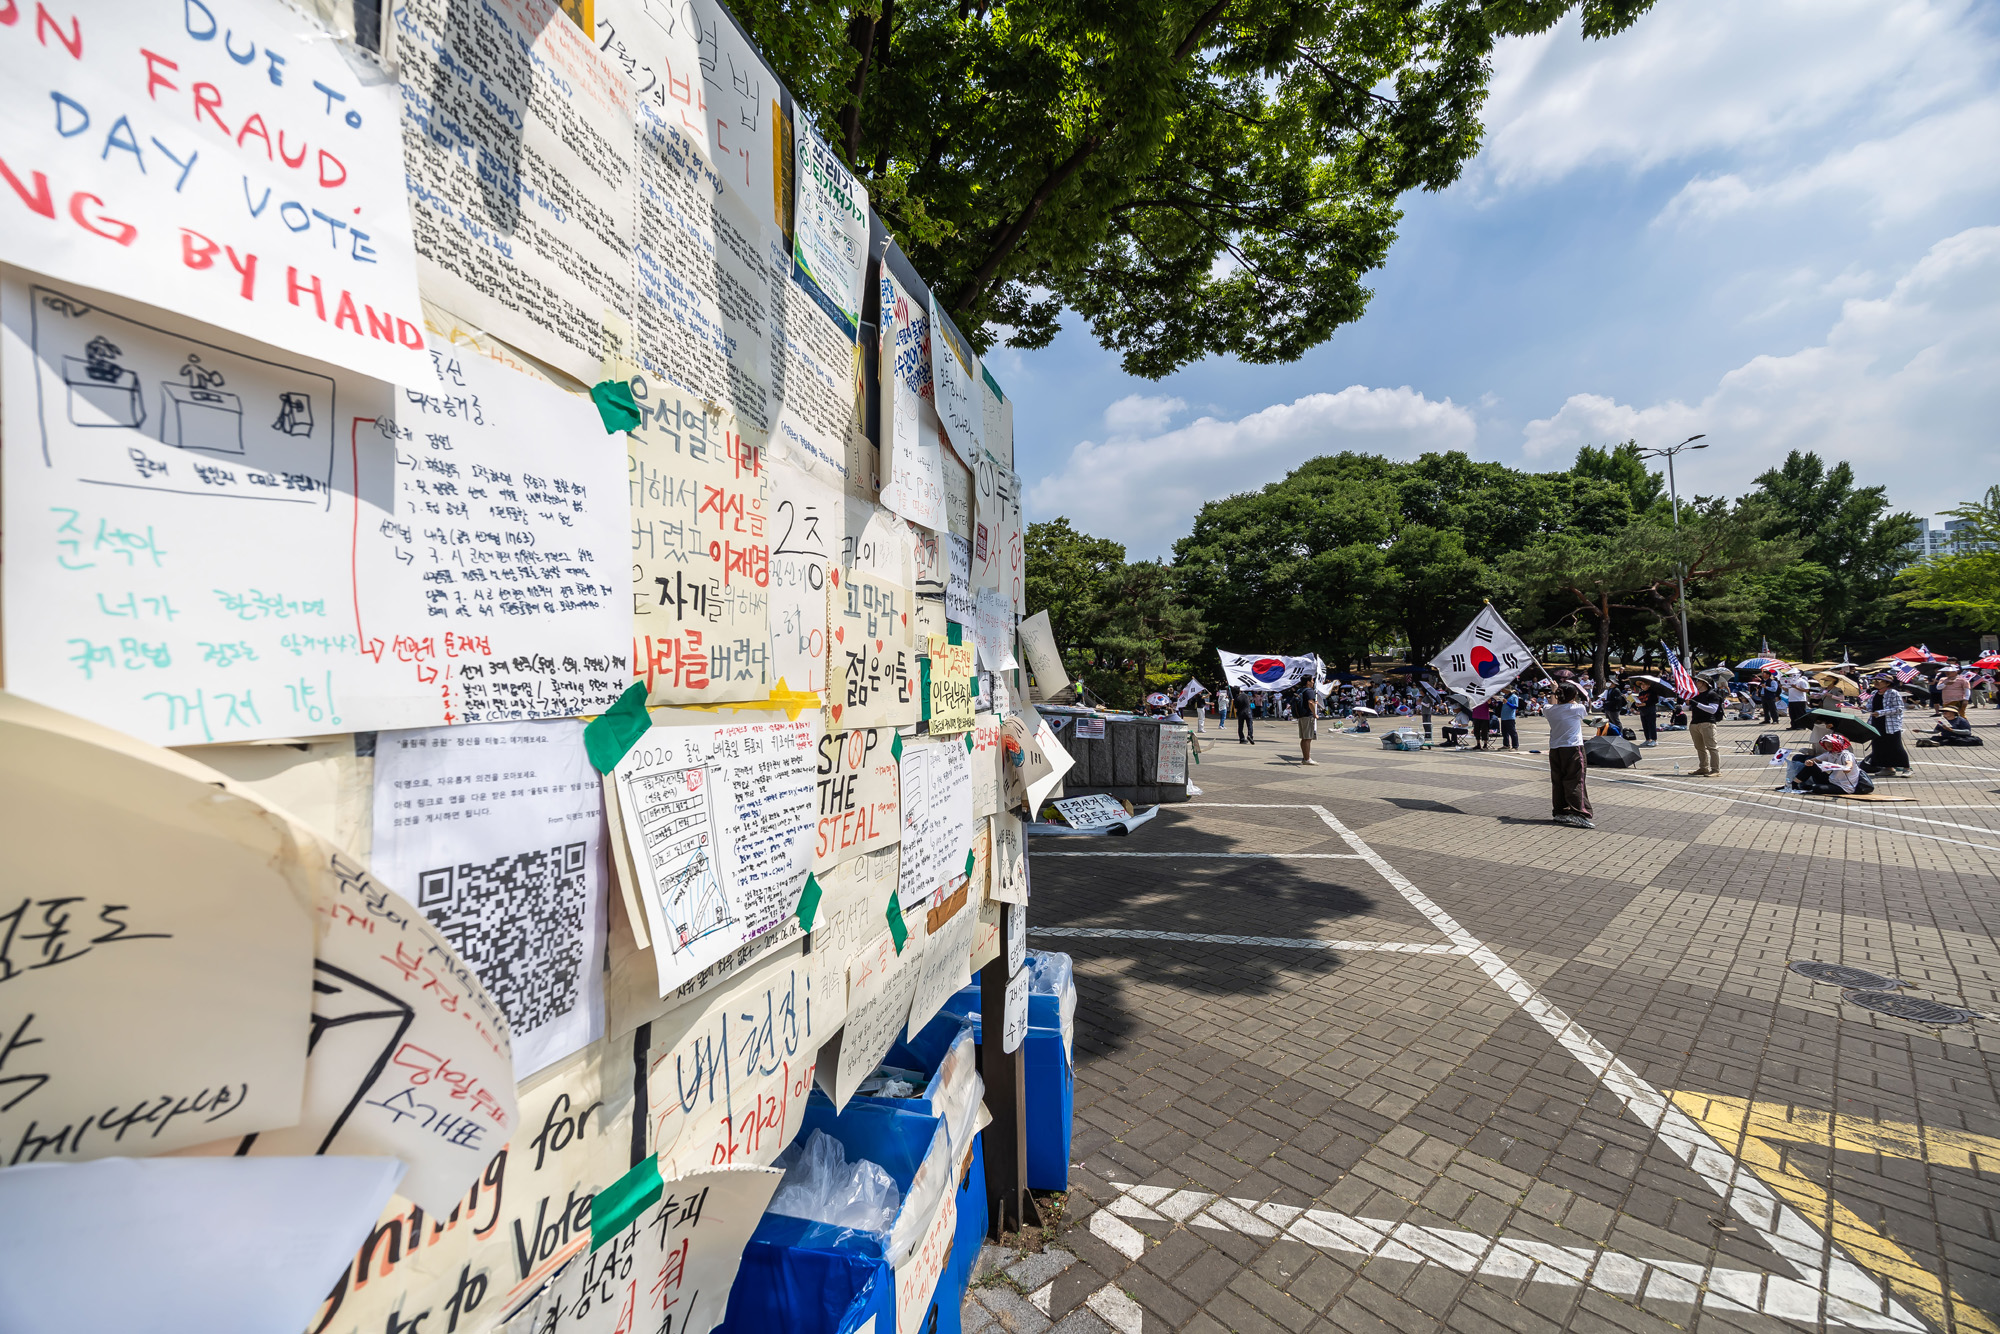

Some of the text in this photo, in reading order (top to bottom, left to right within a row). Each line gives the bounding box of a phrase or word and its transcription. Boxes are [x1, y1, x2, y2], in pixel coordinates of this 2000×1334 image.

[184, 0, 363, 129] DUE TO
[50, 90, 378, 265] DAY VOTE
[178, 226, 258, 302] BY
[286, 265, 425, 352] HAND
[698, 484, 768, 538] 자신을
[50, 508, 168, 571] 준석아
[709, 540, 770, 588] 이재명
[97, 592, 181, 622] 너가
[655, 570, 725, 623] 자기를
[843, 580, 899, 639] 고맙다
[633, 629, 710, 695] 나라를
[711, 637, 771, 685] 버렸다
[845, 644, 910, 709] 젊은이들
[633, 747, 673, 771] 2020
[817, 727, 879, 775] STOP
[437, 775, 472, 786] 자유롭게
[817, 773, 859, 816] THE
[548, 815, 564, 825] From
[815, 803, 881, 859] STEAL
[529, 1092, 604, 1172] for
